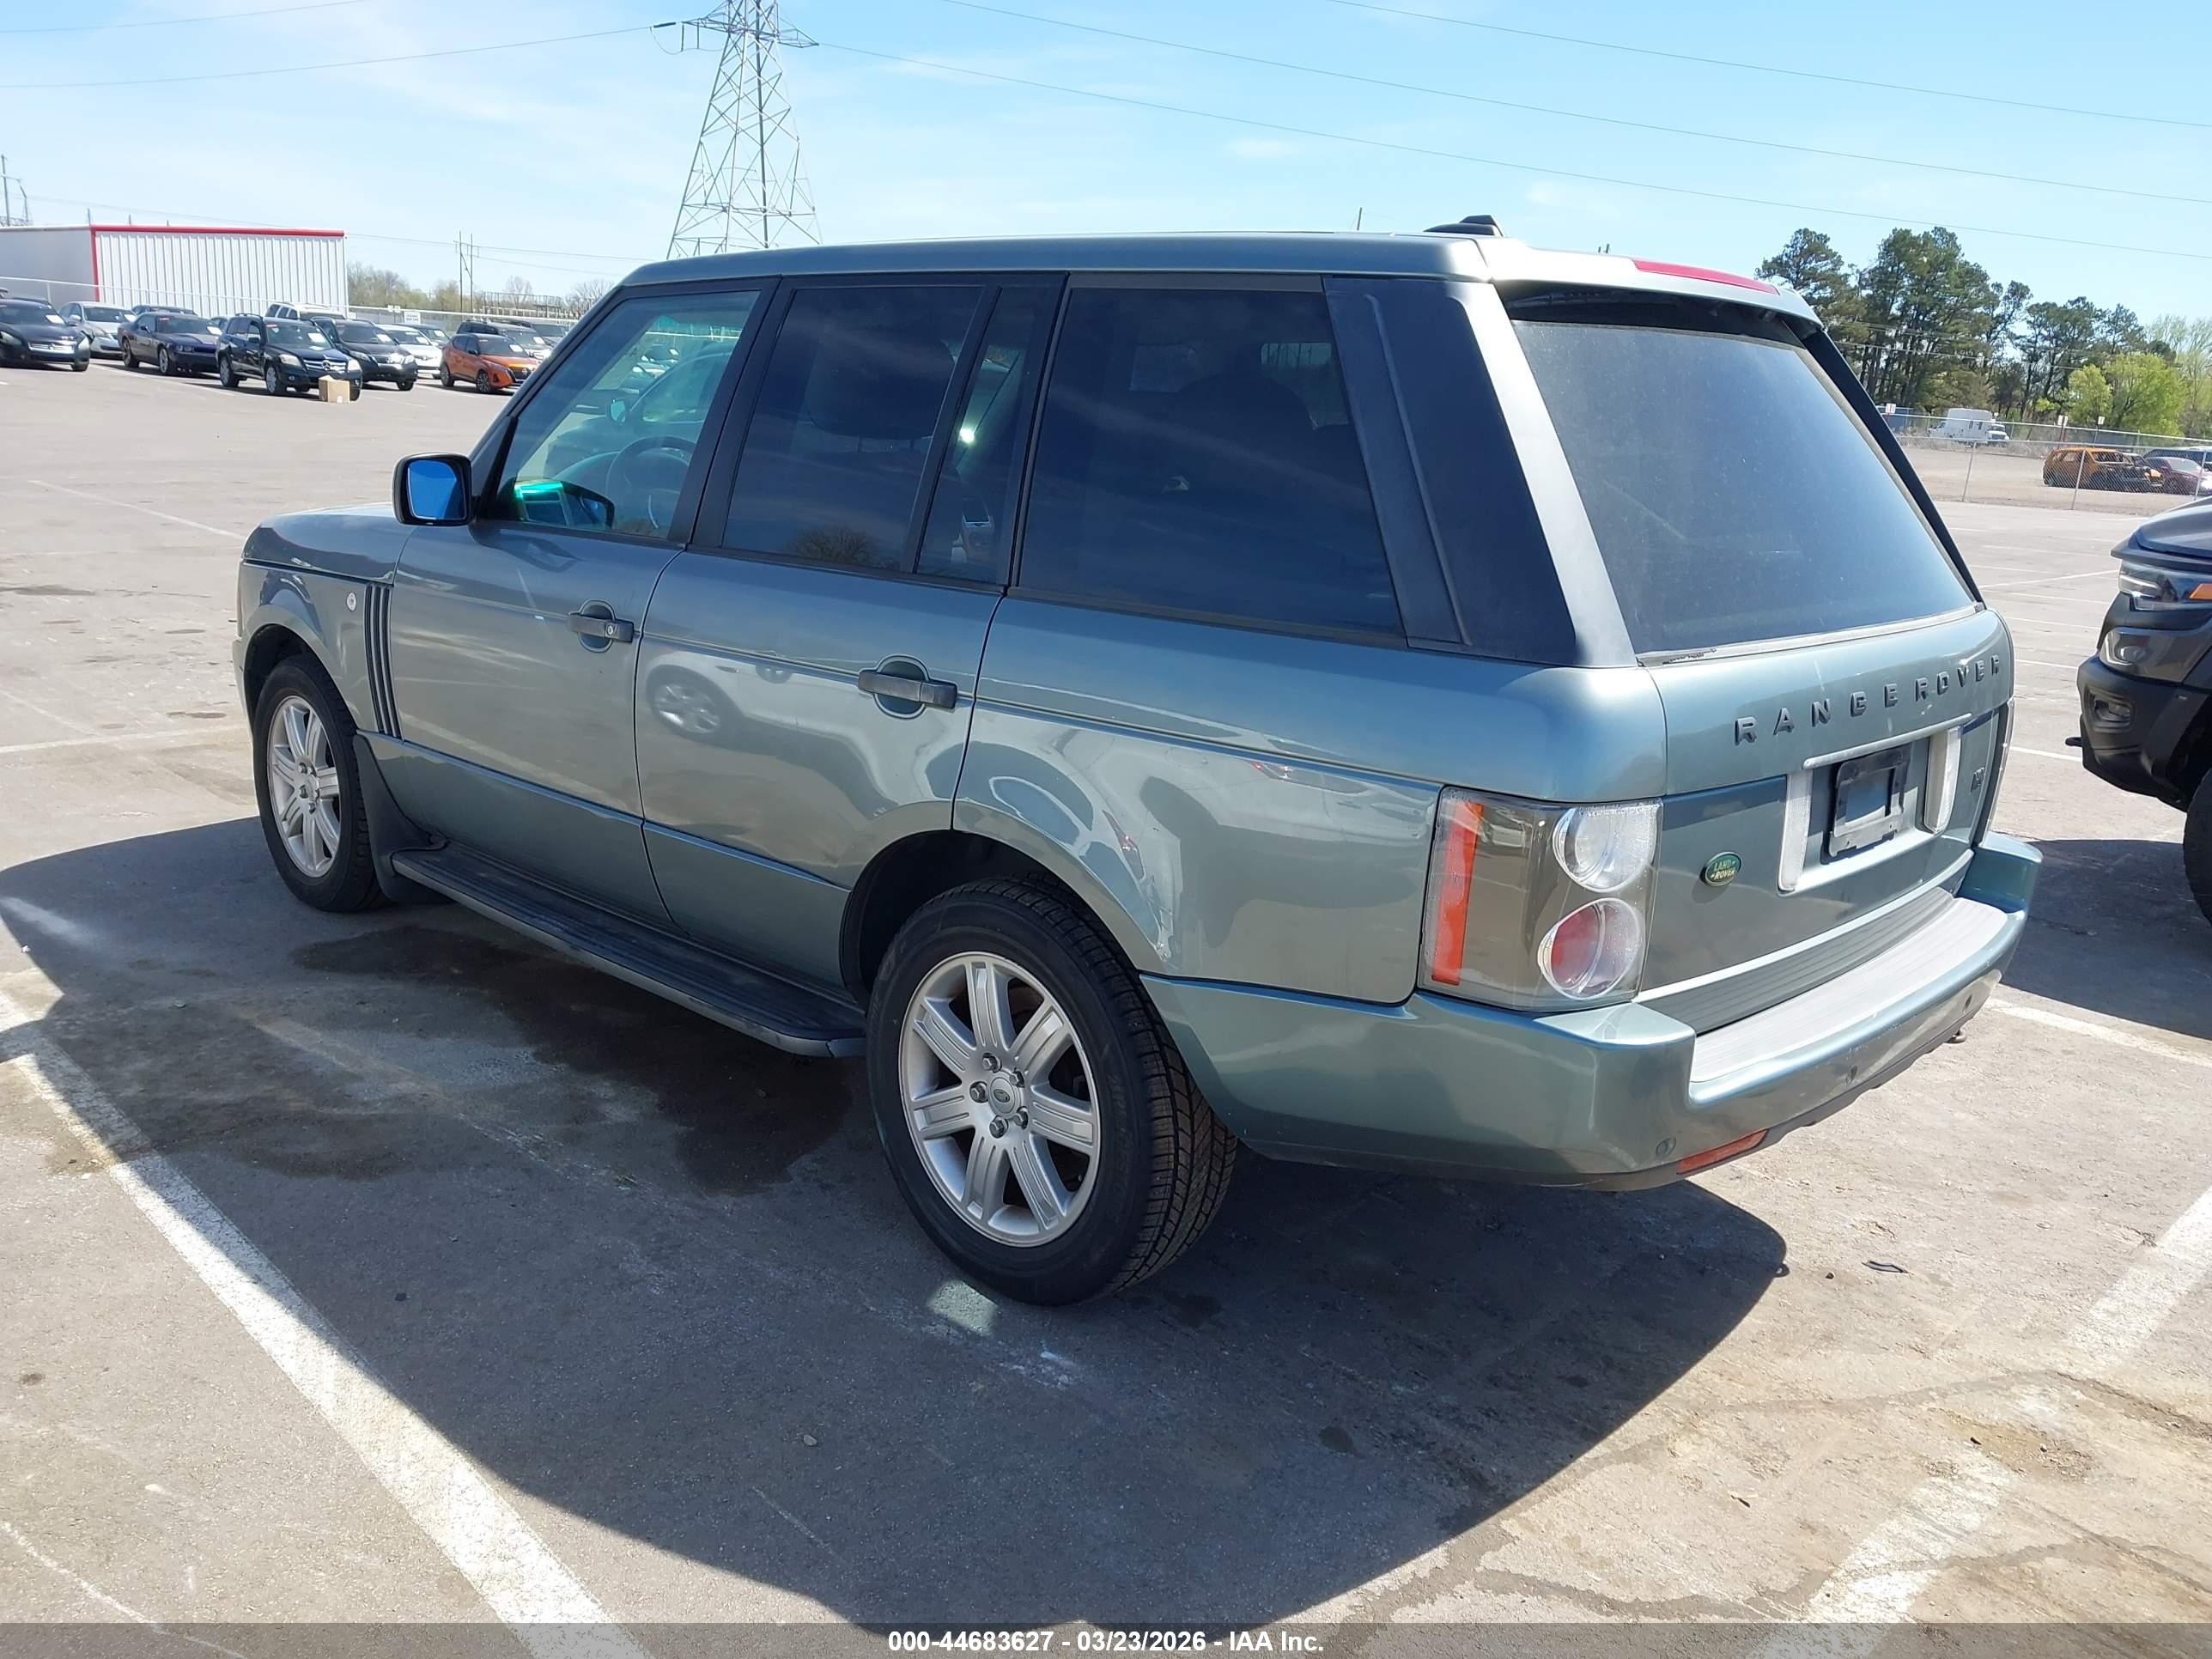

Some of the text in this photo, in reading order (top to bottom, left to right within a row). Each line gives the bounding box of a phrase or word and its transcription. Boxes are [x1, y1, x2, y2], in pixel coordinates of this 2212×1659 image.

[1734, 654, 2001, 746] RANGE ROVER
[1713, 860, 1732, 872] LAND
